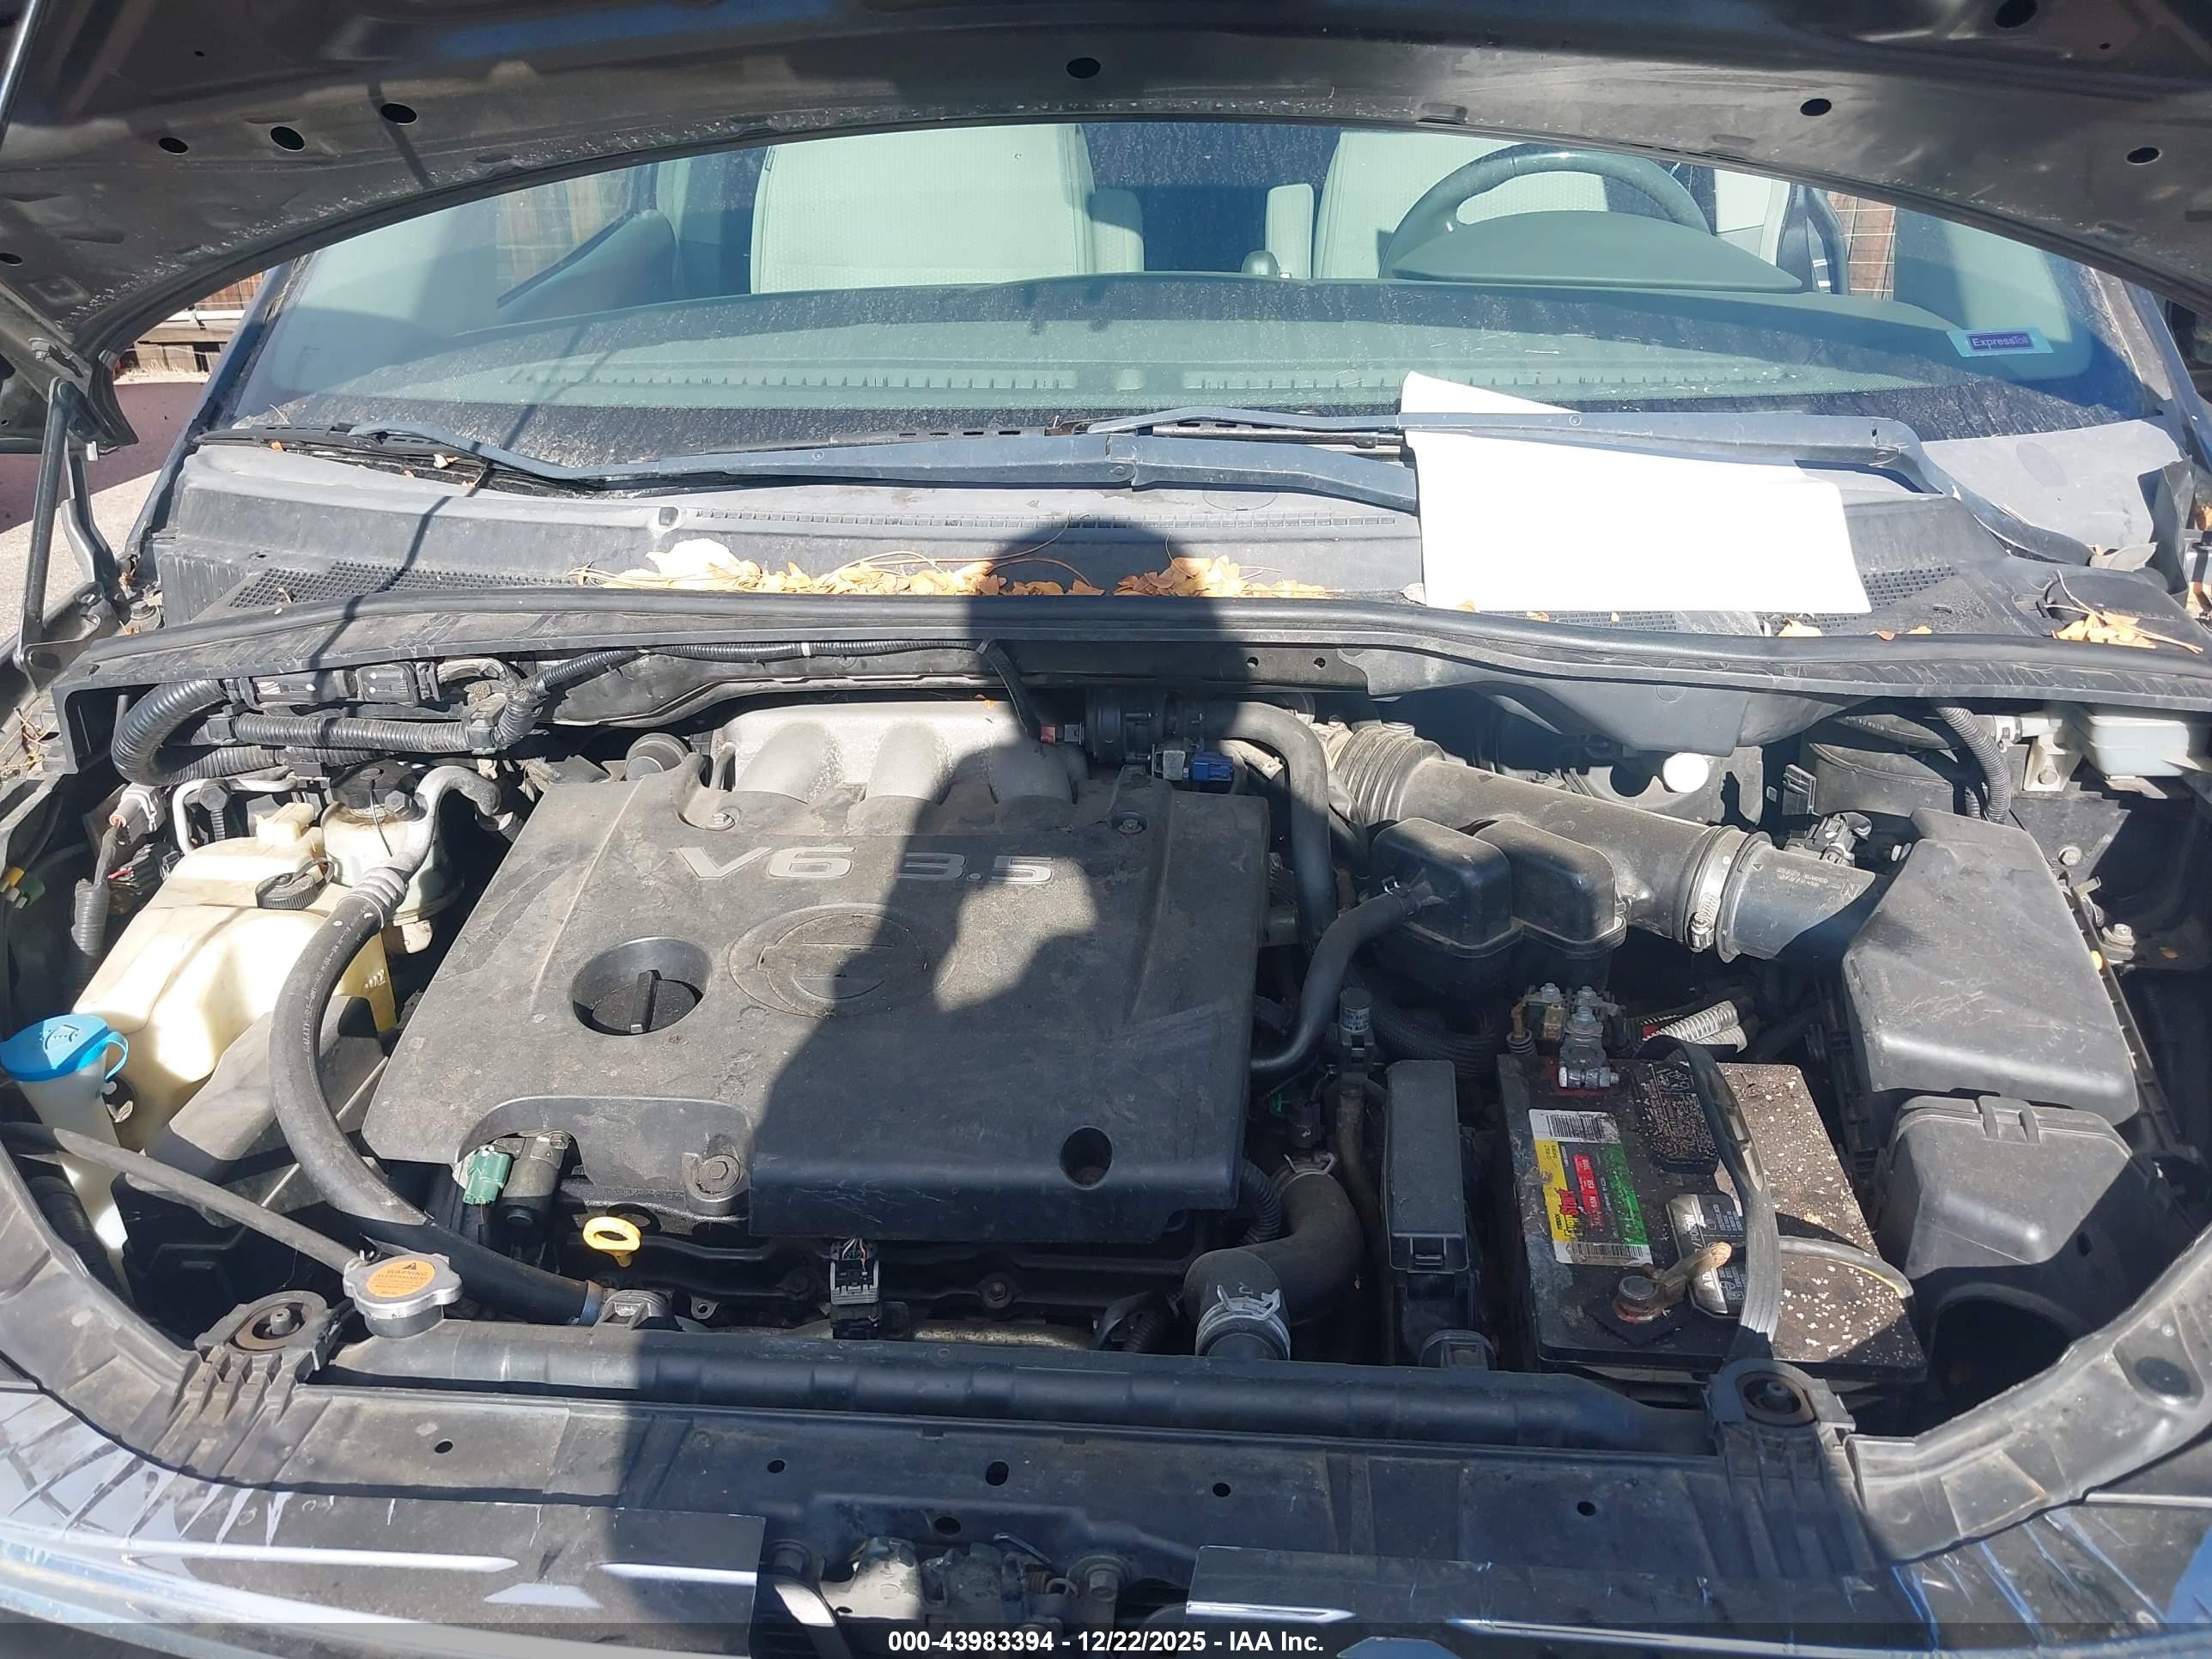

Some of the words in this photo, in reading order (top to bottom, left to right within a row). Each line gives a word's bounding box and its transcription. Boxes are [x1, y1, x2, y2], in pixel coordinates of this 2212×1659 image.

[1972, 336, 2029, 350] ExpressToll
[678, 846, 857, 880] V6
[898, 852, 1054, 884] 3.5
